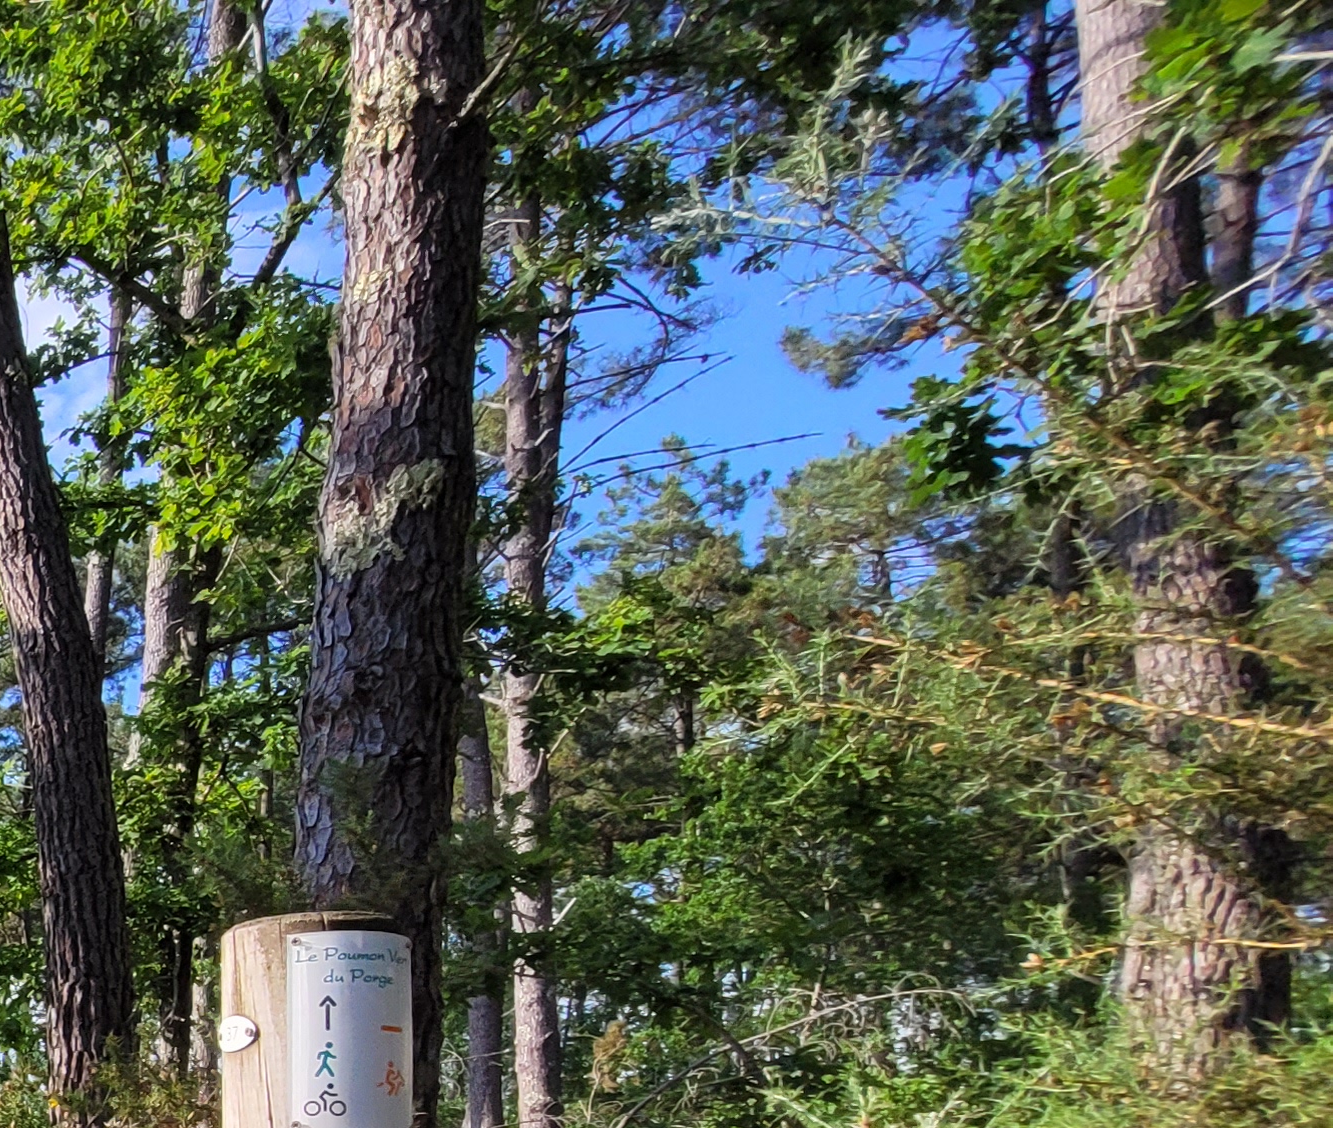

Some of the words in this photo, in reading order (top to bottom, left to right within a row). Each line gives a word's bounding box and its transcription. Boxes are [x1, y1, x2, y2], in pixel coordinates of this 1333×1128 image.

[295, 950, 318, 963] Le
[323, 947, 385, 961] Poumon
[323, 969, 345, 983] du
[350, 969, 394, 988] Porge
